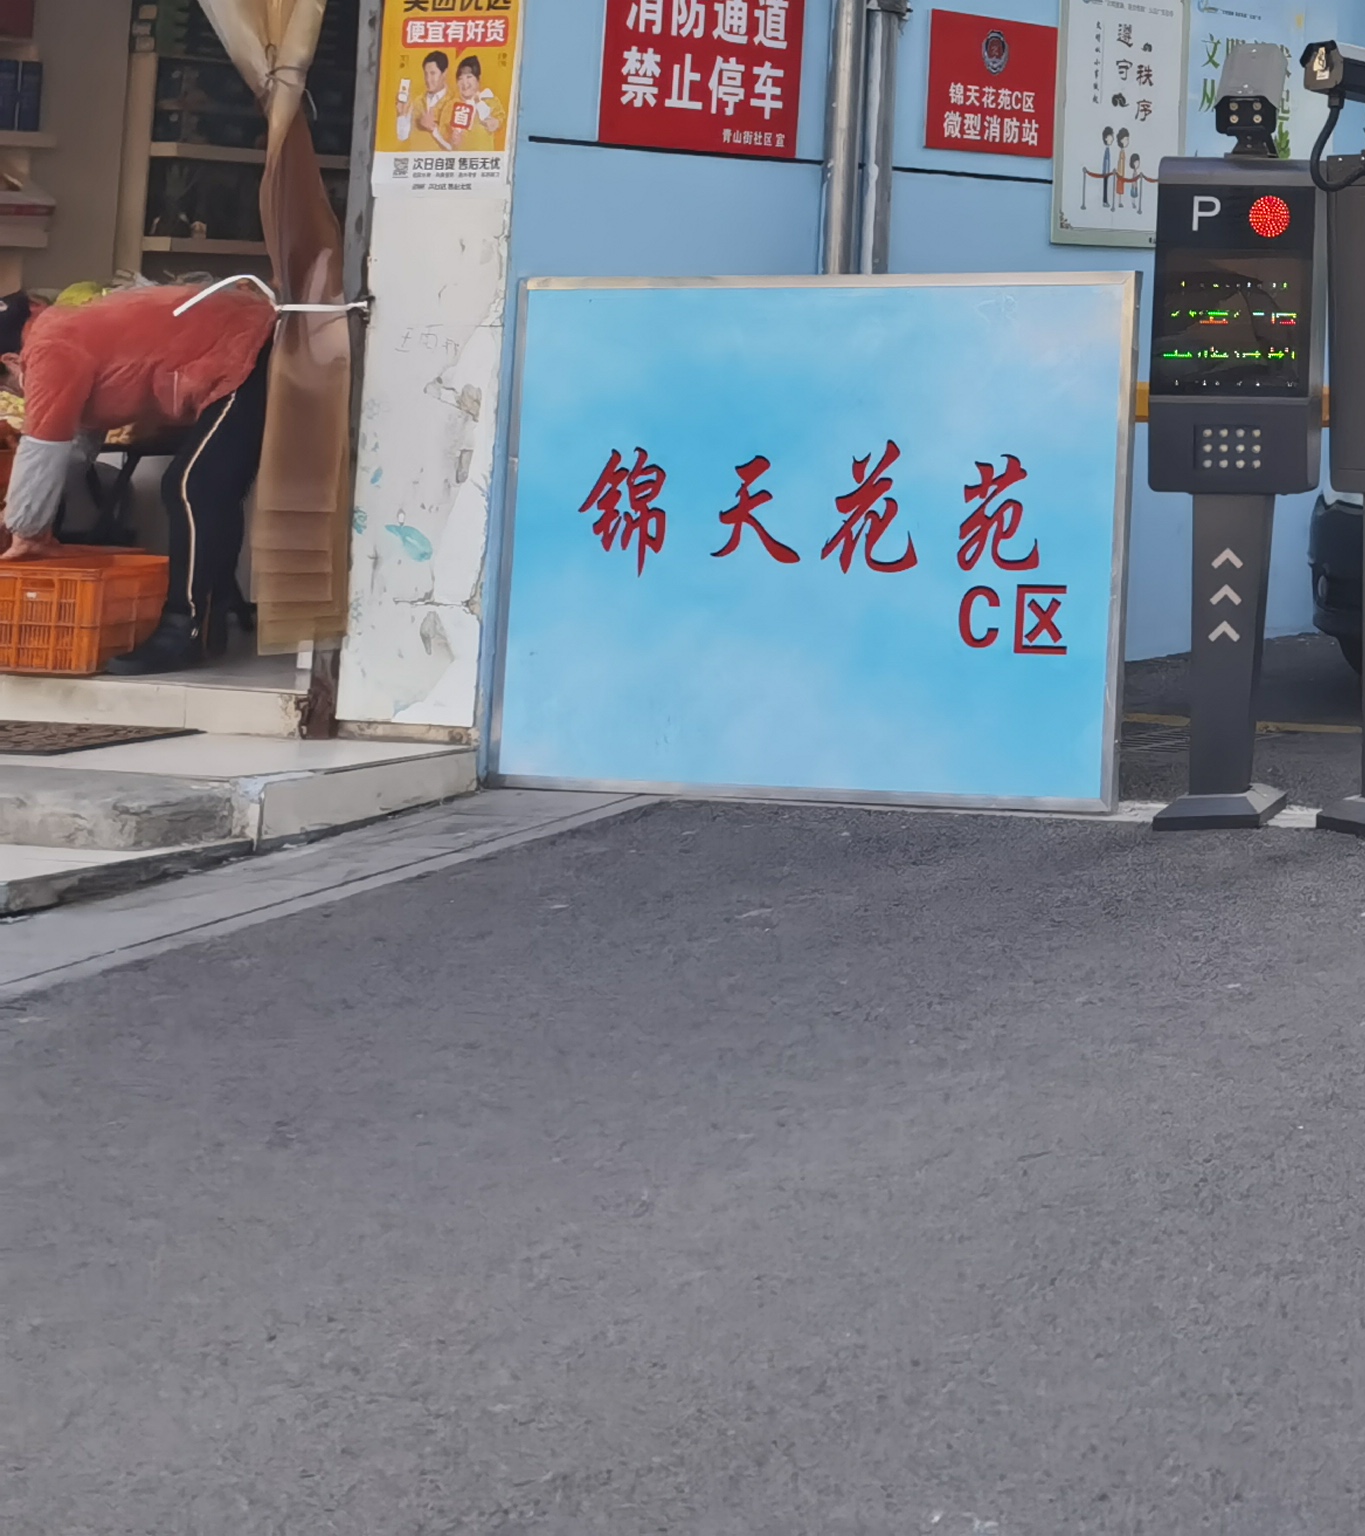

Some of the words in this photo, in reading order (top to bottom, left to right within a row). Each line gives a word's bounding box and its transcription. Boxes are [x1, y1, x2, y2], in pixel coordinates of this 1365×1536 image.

[406, 19, 506, 44] 便宜有好货
[620, 46, 784, 120] 禁止停车
[949, 82, 1036, 113] 锦天花苑C区
[454, 105, 470, 126] 省
[943, 111, 1039, 146] 微型消防站
[722, 128, 773, 146] 青山街社区
[458, 157, 501, 171] 售后无忧
[1191, 195, 1222, 232] P
[577, 439, 1040, 578] 锦天花苑
[958, 584, 1067, 655] C区
